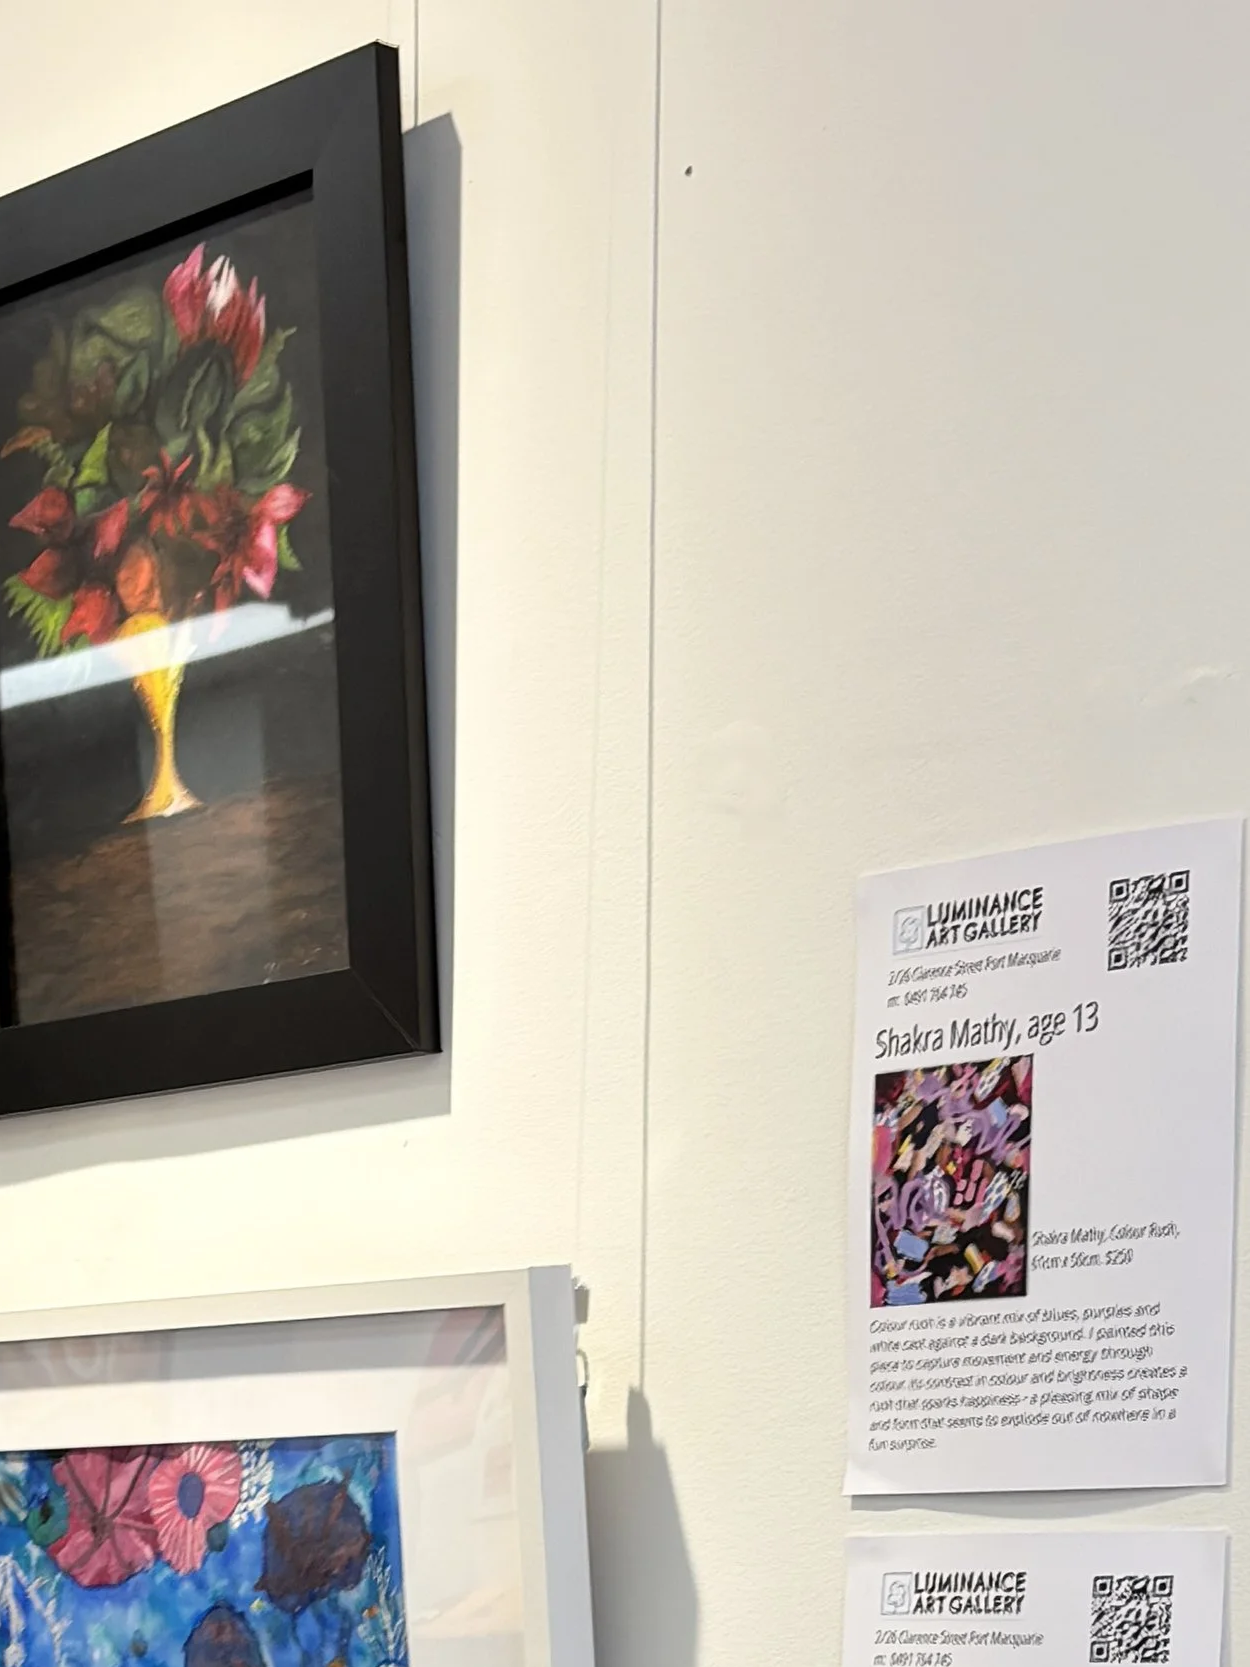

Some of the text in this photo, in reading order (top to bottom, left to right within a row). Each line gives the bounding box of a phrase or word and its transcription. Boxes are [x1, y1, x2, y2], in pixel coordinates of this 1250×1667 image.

[927, 887, 1044, 927] LUMINANCE
[926, 911, 1043, 949] ART GALLERY
[954, 959, 983, 976] Street
[875, 1000, 1099, 1059] Shakra Mathy, age 13
[936, 1315, 946, 1330] is
[1025, 1307, 1041, 1323] of
[914, 1571, 1027, 1594] LUMINANCE
[912, 1595, 1025, 1615] ART GALLERY
